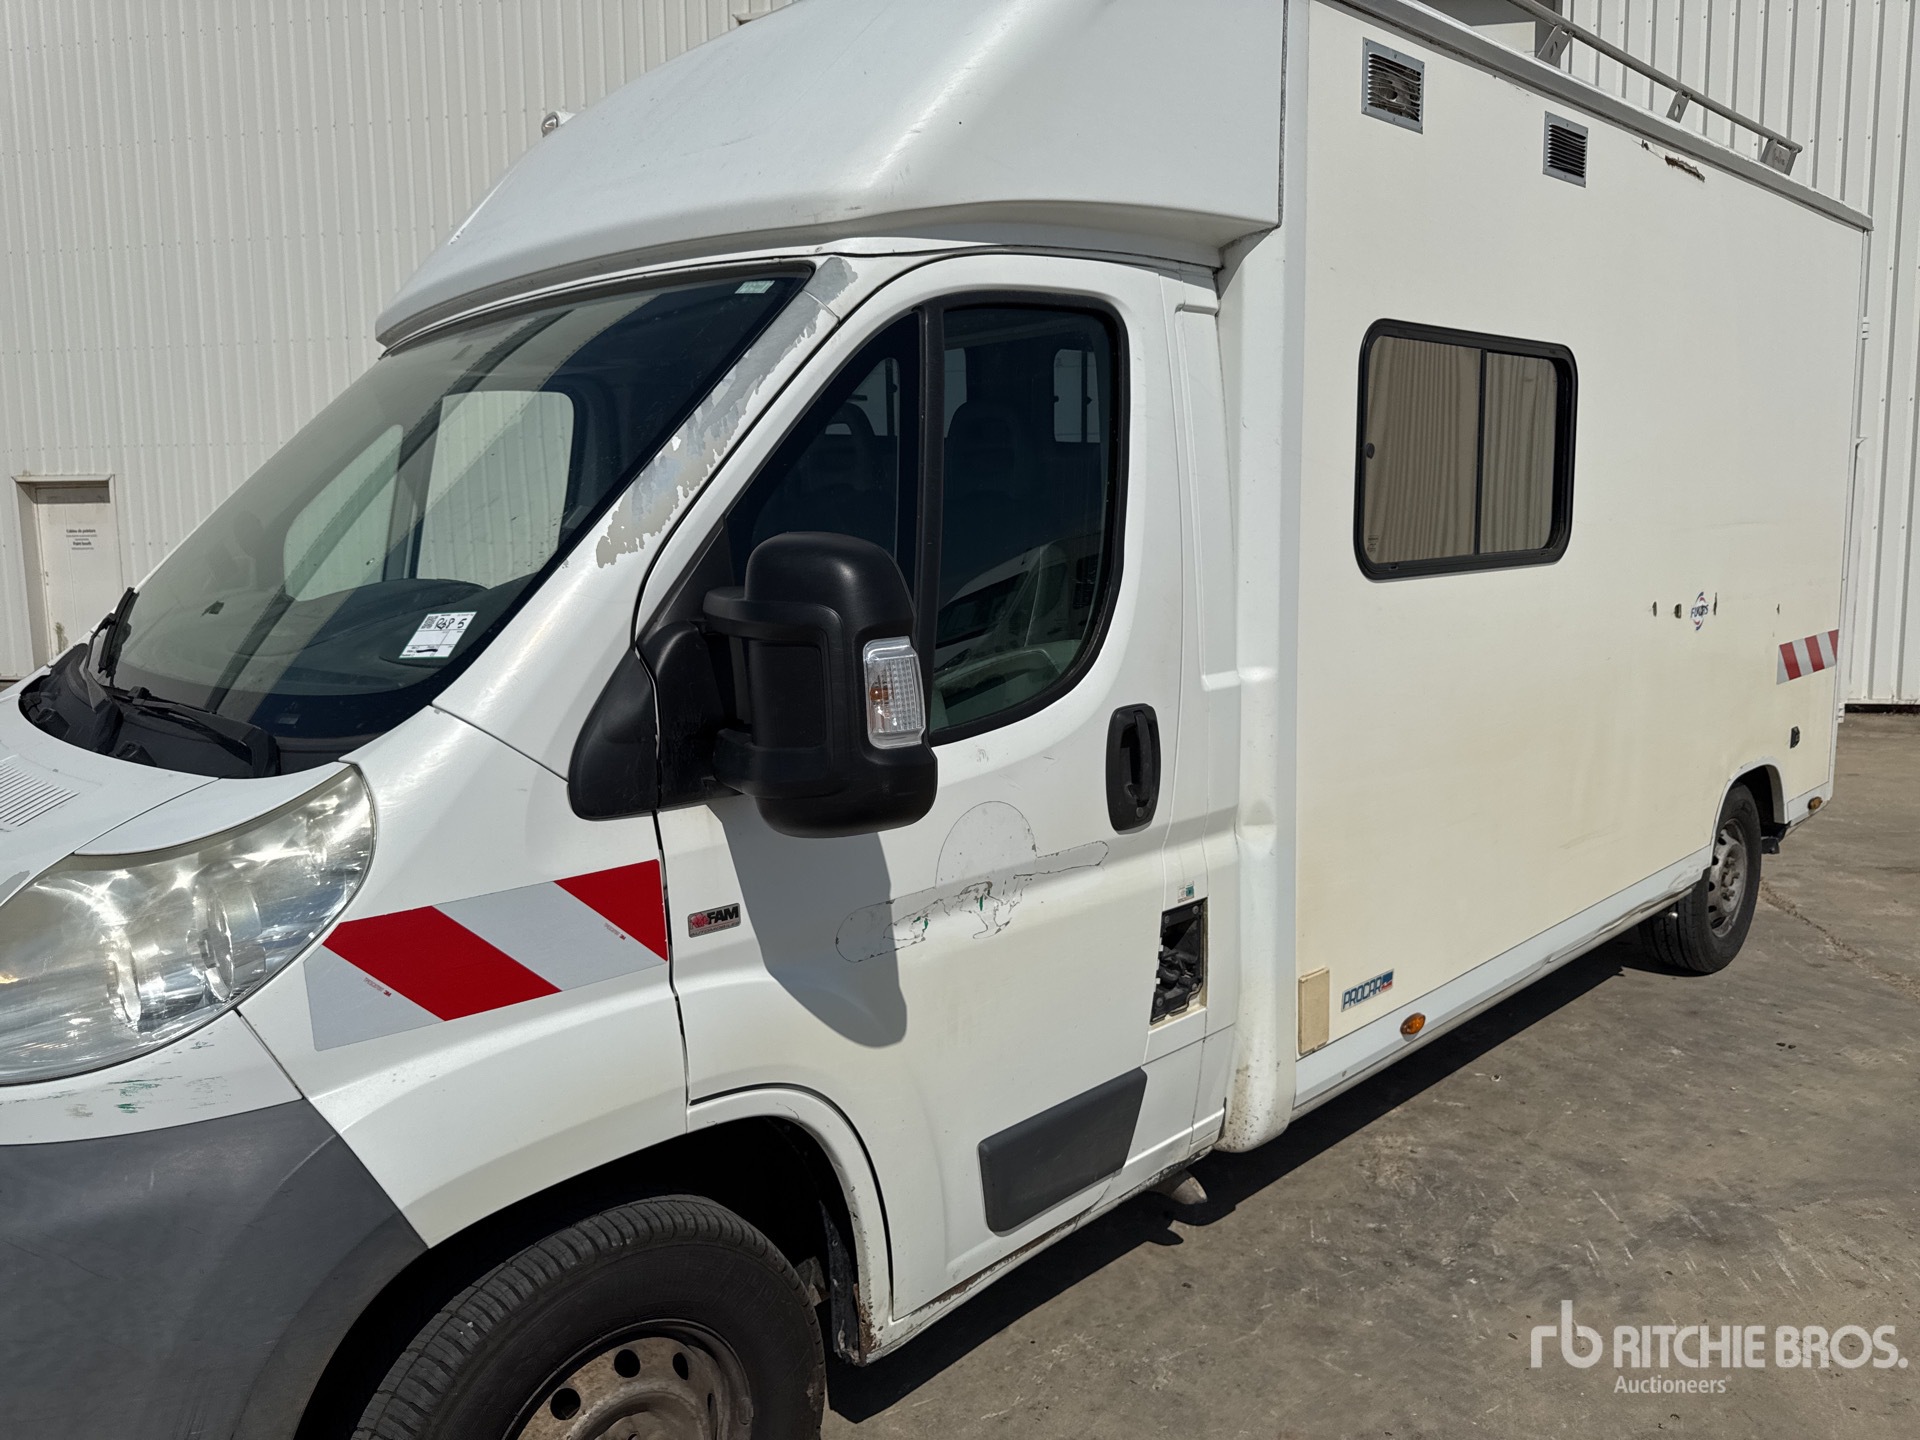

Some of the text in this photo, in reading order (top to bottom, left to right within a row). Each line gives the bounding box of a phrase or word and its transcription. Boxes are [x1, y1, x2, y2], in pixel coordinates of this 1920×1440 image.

[457, 617, 468, 629] 5
[706, 906, 739, 925] FAM
[1342, 976, 1383, 1010] PROCAR
